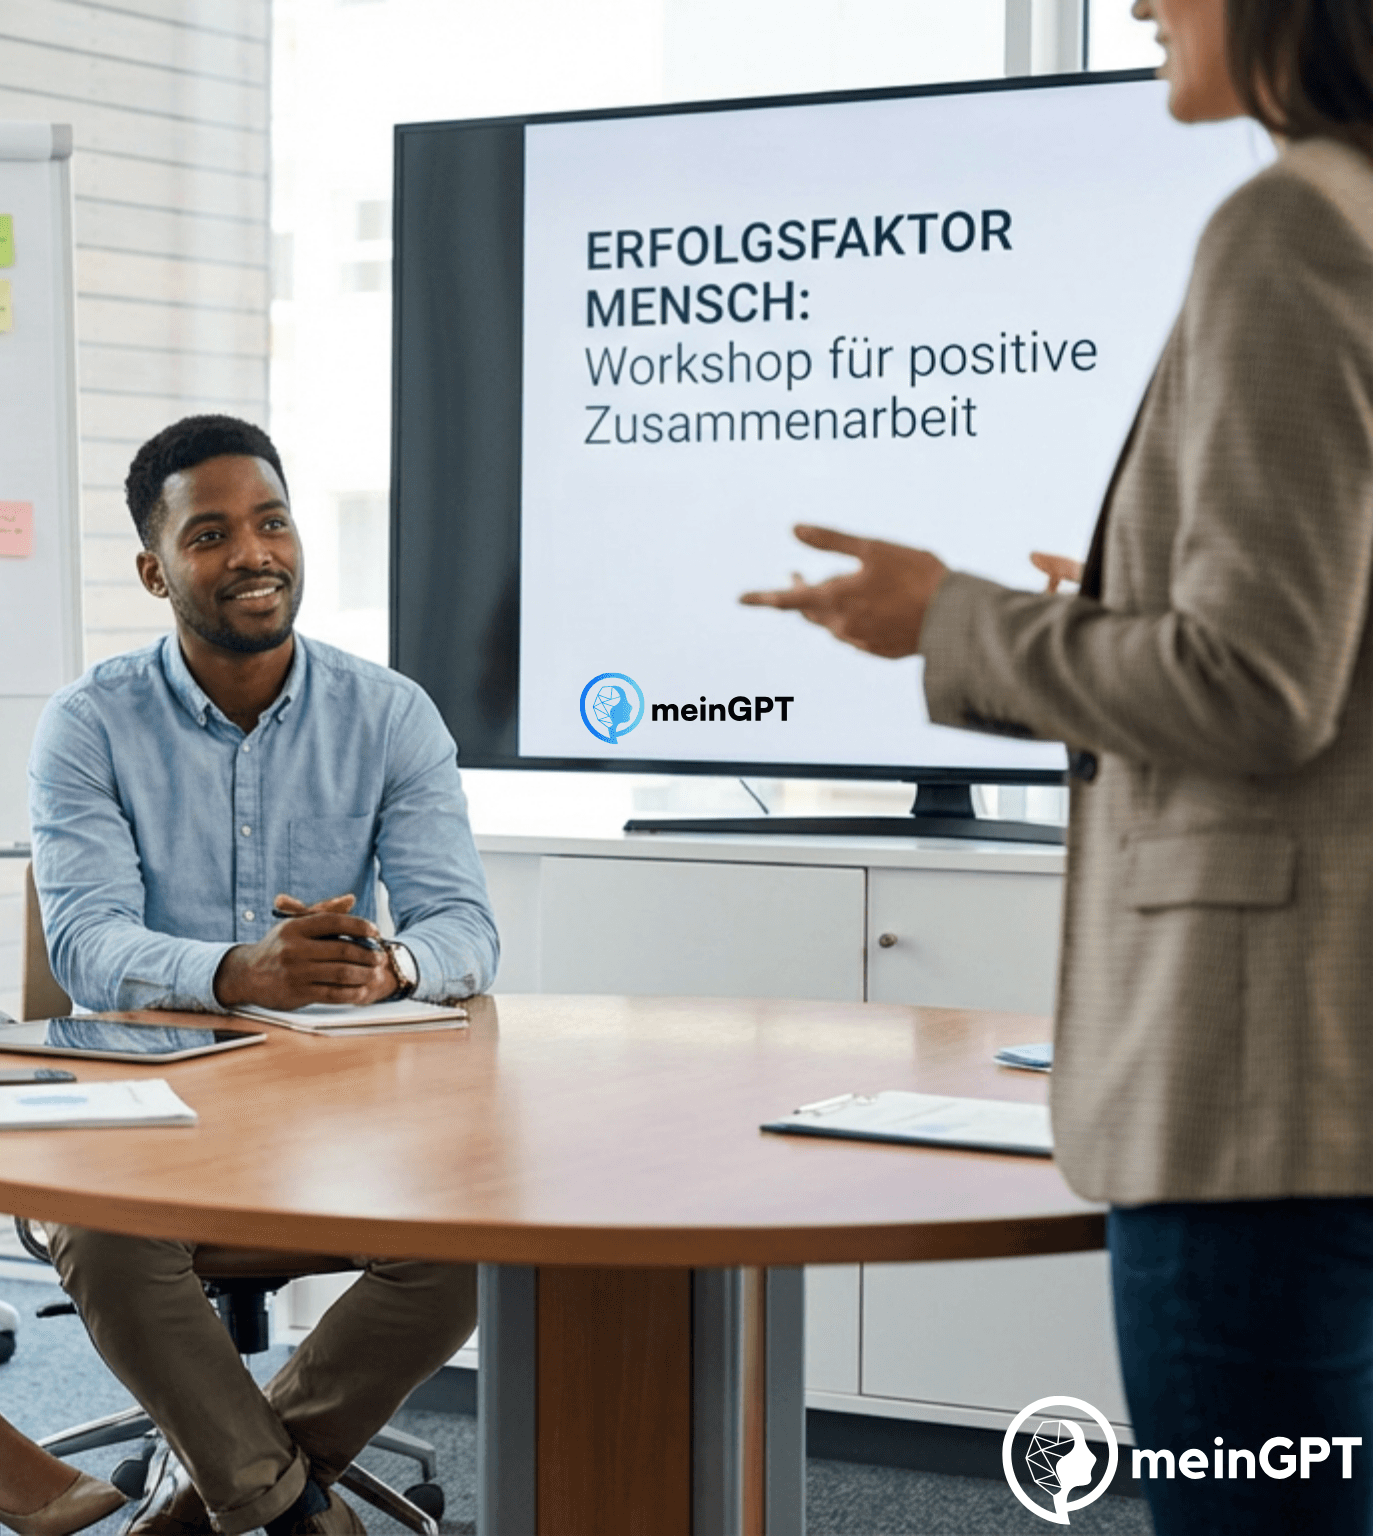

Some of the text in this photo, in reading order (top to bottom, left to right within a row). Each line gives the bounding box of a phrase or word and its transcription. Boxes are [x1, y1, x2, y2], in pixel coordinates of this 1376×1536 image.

[588, 210, 1012, 270] ERFOLGSFAKTOR
[588, 281, 808, 327] MENSCH:
[586, 330, 1097, 391] Workshop für positive
[585, 396, 976, 444] Zusammenarbeit
[652, 696, 794, 721] meinGPT
